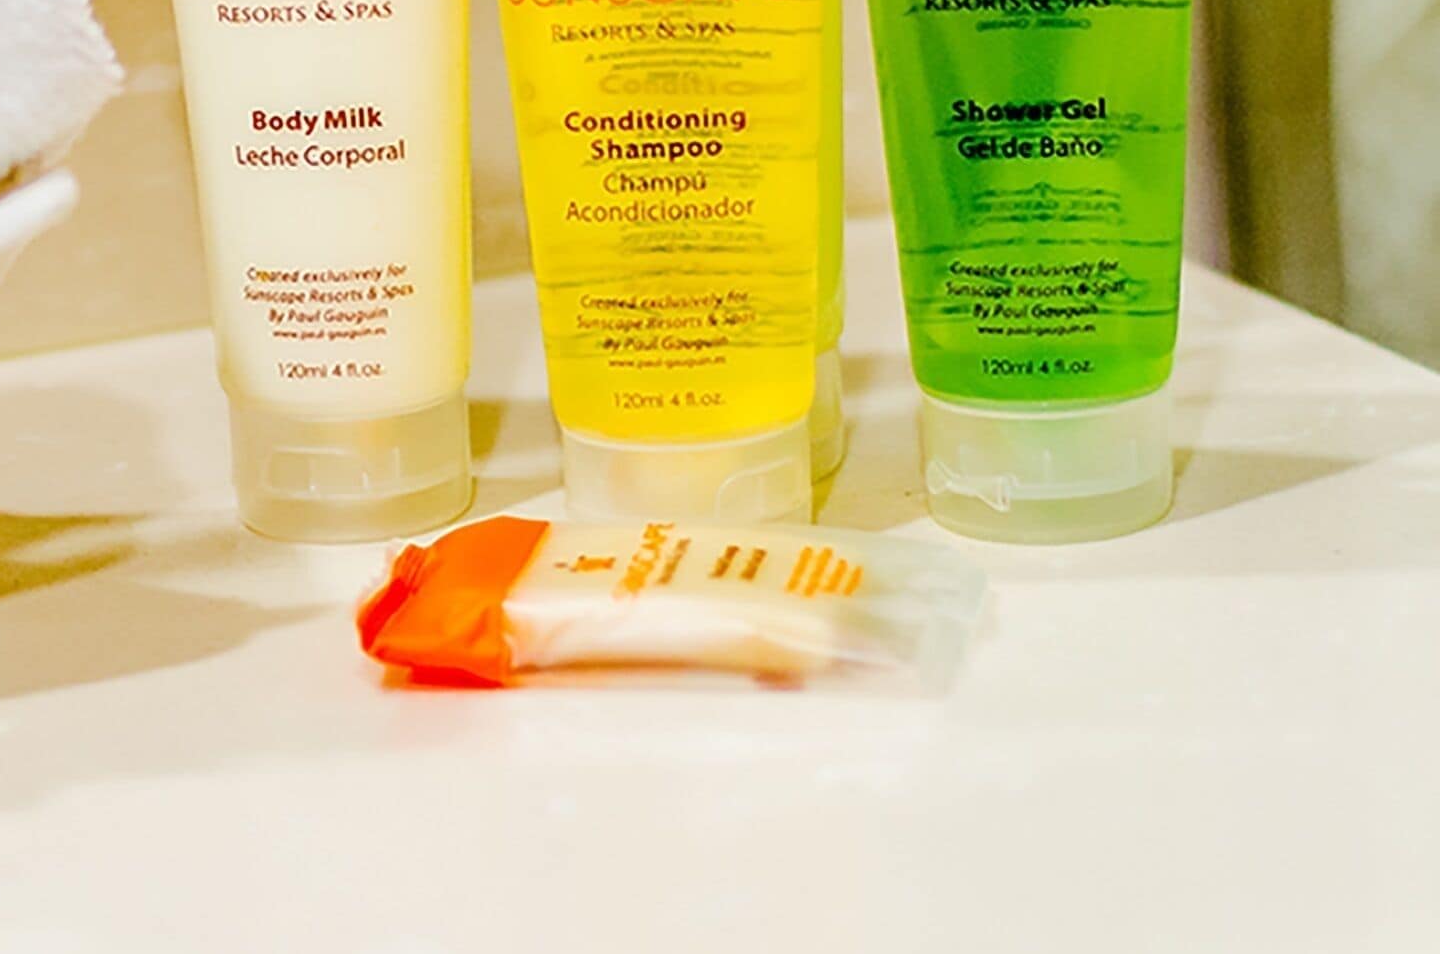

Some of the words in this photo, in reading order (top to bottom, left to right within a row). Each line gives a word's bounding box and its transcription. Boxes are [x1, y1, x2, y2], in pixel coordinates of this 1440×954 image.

[218, 4, 307, 22] RESORTS
[314, 0, 336, 22] &
[344, 1, 392, 20] SPAS
[551, 23, 646, 41] RESORTS
[655, 20, 677, 39] &
[686, 22, 736, 36] SPAS
[564, 107, 746, 132] Conditioning
[951, 100, 1054, 122] Shower
[1062, 98, 1106, 120] Gel
[252, 110, 318, 135] Body
[324, 107, 382, 129] Milk
[236, 146, 298, 166] Leche
[304, 140, 406, 168] Corporal
[590, 138, 723, 162] Shampoo
[958, 136, 997, 158] Gel
[1001, 138, 1032, 158] de
[1040, 136, 1102, 158] Baño
[603, 172, 708, 196] Champú
[566, 197, 754, 222] Acondicionador
[246, 267, 299, 282] Created
[303, 269, 383, 284] exclusively
[386, 264, 407, 278] for
[950, 261, 1007, 276] Created
[1011, 262, 1093, 278] exclusively
[1097, 260, 1119, 274] for
[244, 286, 306, 304] Sunscape
[310, 290, 363, 303] Resorts
[367, 287, 377, 300] &
[382, 285, 414, 299] Spas
[580, 295, 637, 309] Created
[640, 294, 723, 309] exclusively
[727, 291, 748, 303] for
[946, 282, 1012, 299] Sunscape
[1018, 285, 1073, 296] Resorts
[269, 309, 284, 325] By
[288, 310, 321, 322] Paul
[323, 307, 389, 324] Gauguin
[973, 305, 990, 318] By
[994, 304, 1027, 317] Paul
[1031, 304, 1099, 319] Gauguin
[577, 315, 642, 331] Sunscape
[647, 317, 702, 329] Resorts
[624, 338, 657, 350] Paul
[661, 336, 729, 351] Gauguin
[332, 365, 341, 376] 4
[1039, 361, 1049, 373] 4
[670, 393, 680, 406] 4
